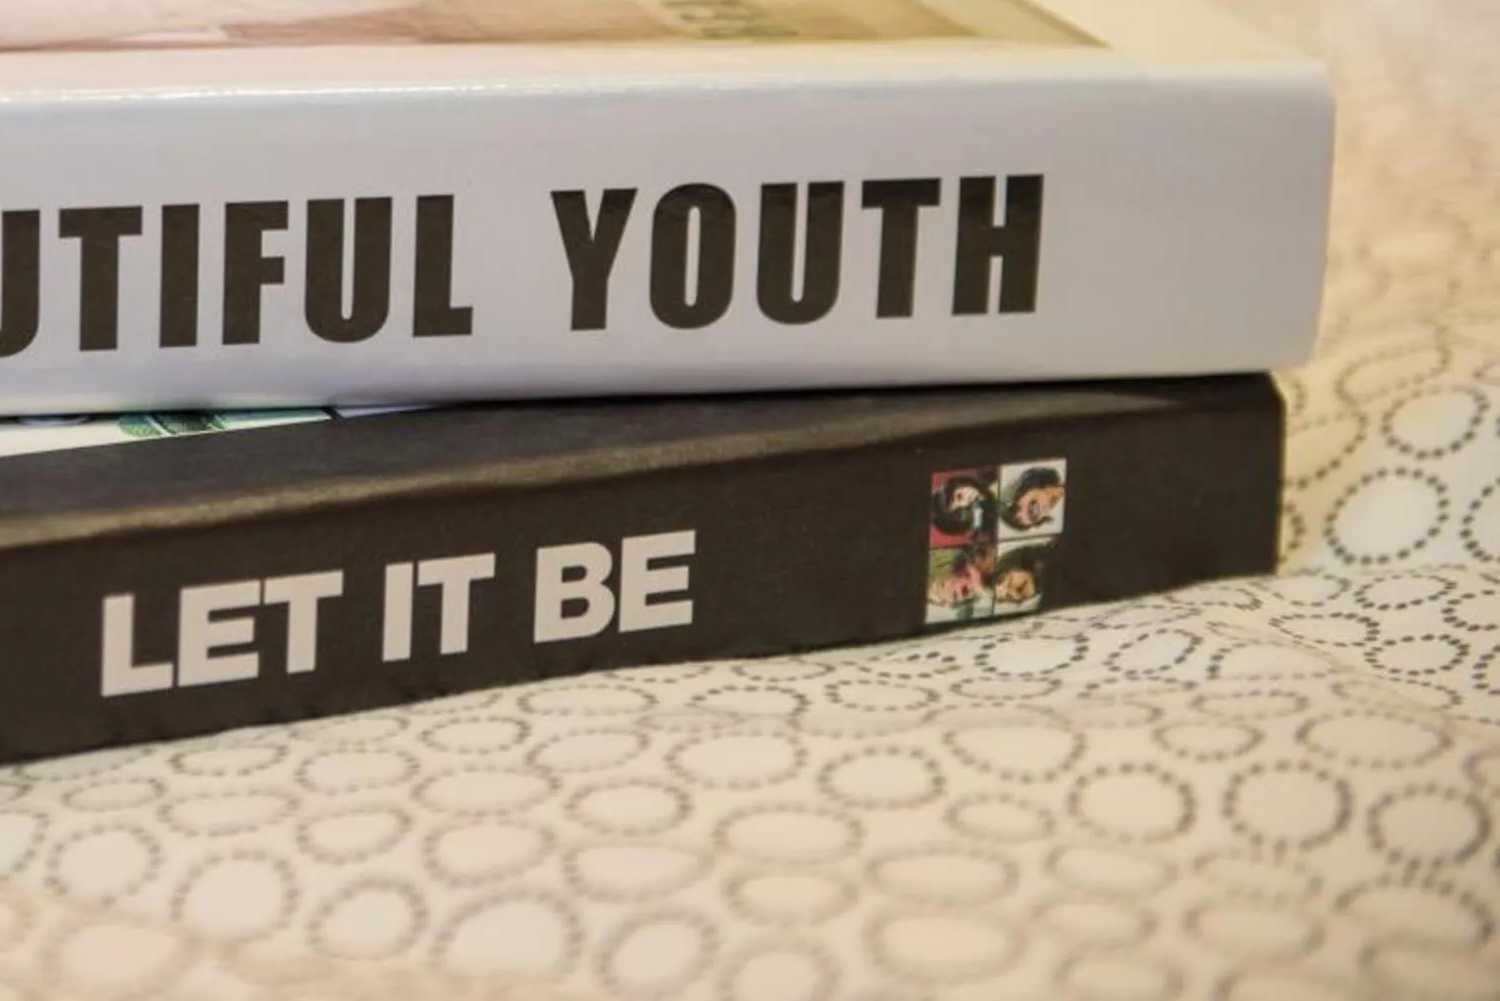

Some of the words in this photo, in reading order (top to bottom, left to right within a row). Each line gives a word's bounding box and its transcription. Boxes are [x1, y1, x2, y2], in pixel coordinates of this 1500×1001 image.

[549, 173, 1045, 331] YOUTH
[101, 569, 344, 698] LET
[382, 552, 496, 662] IT
[533, 529, 697, 644] BE
